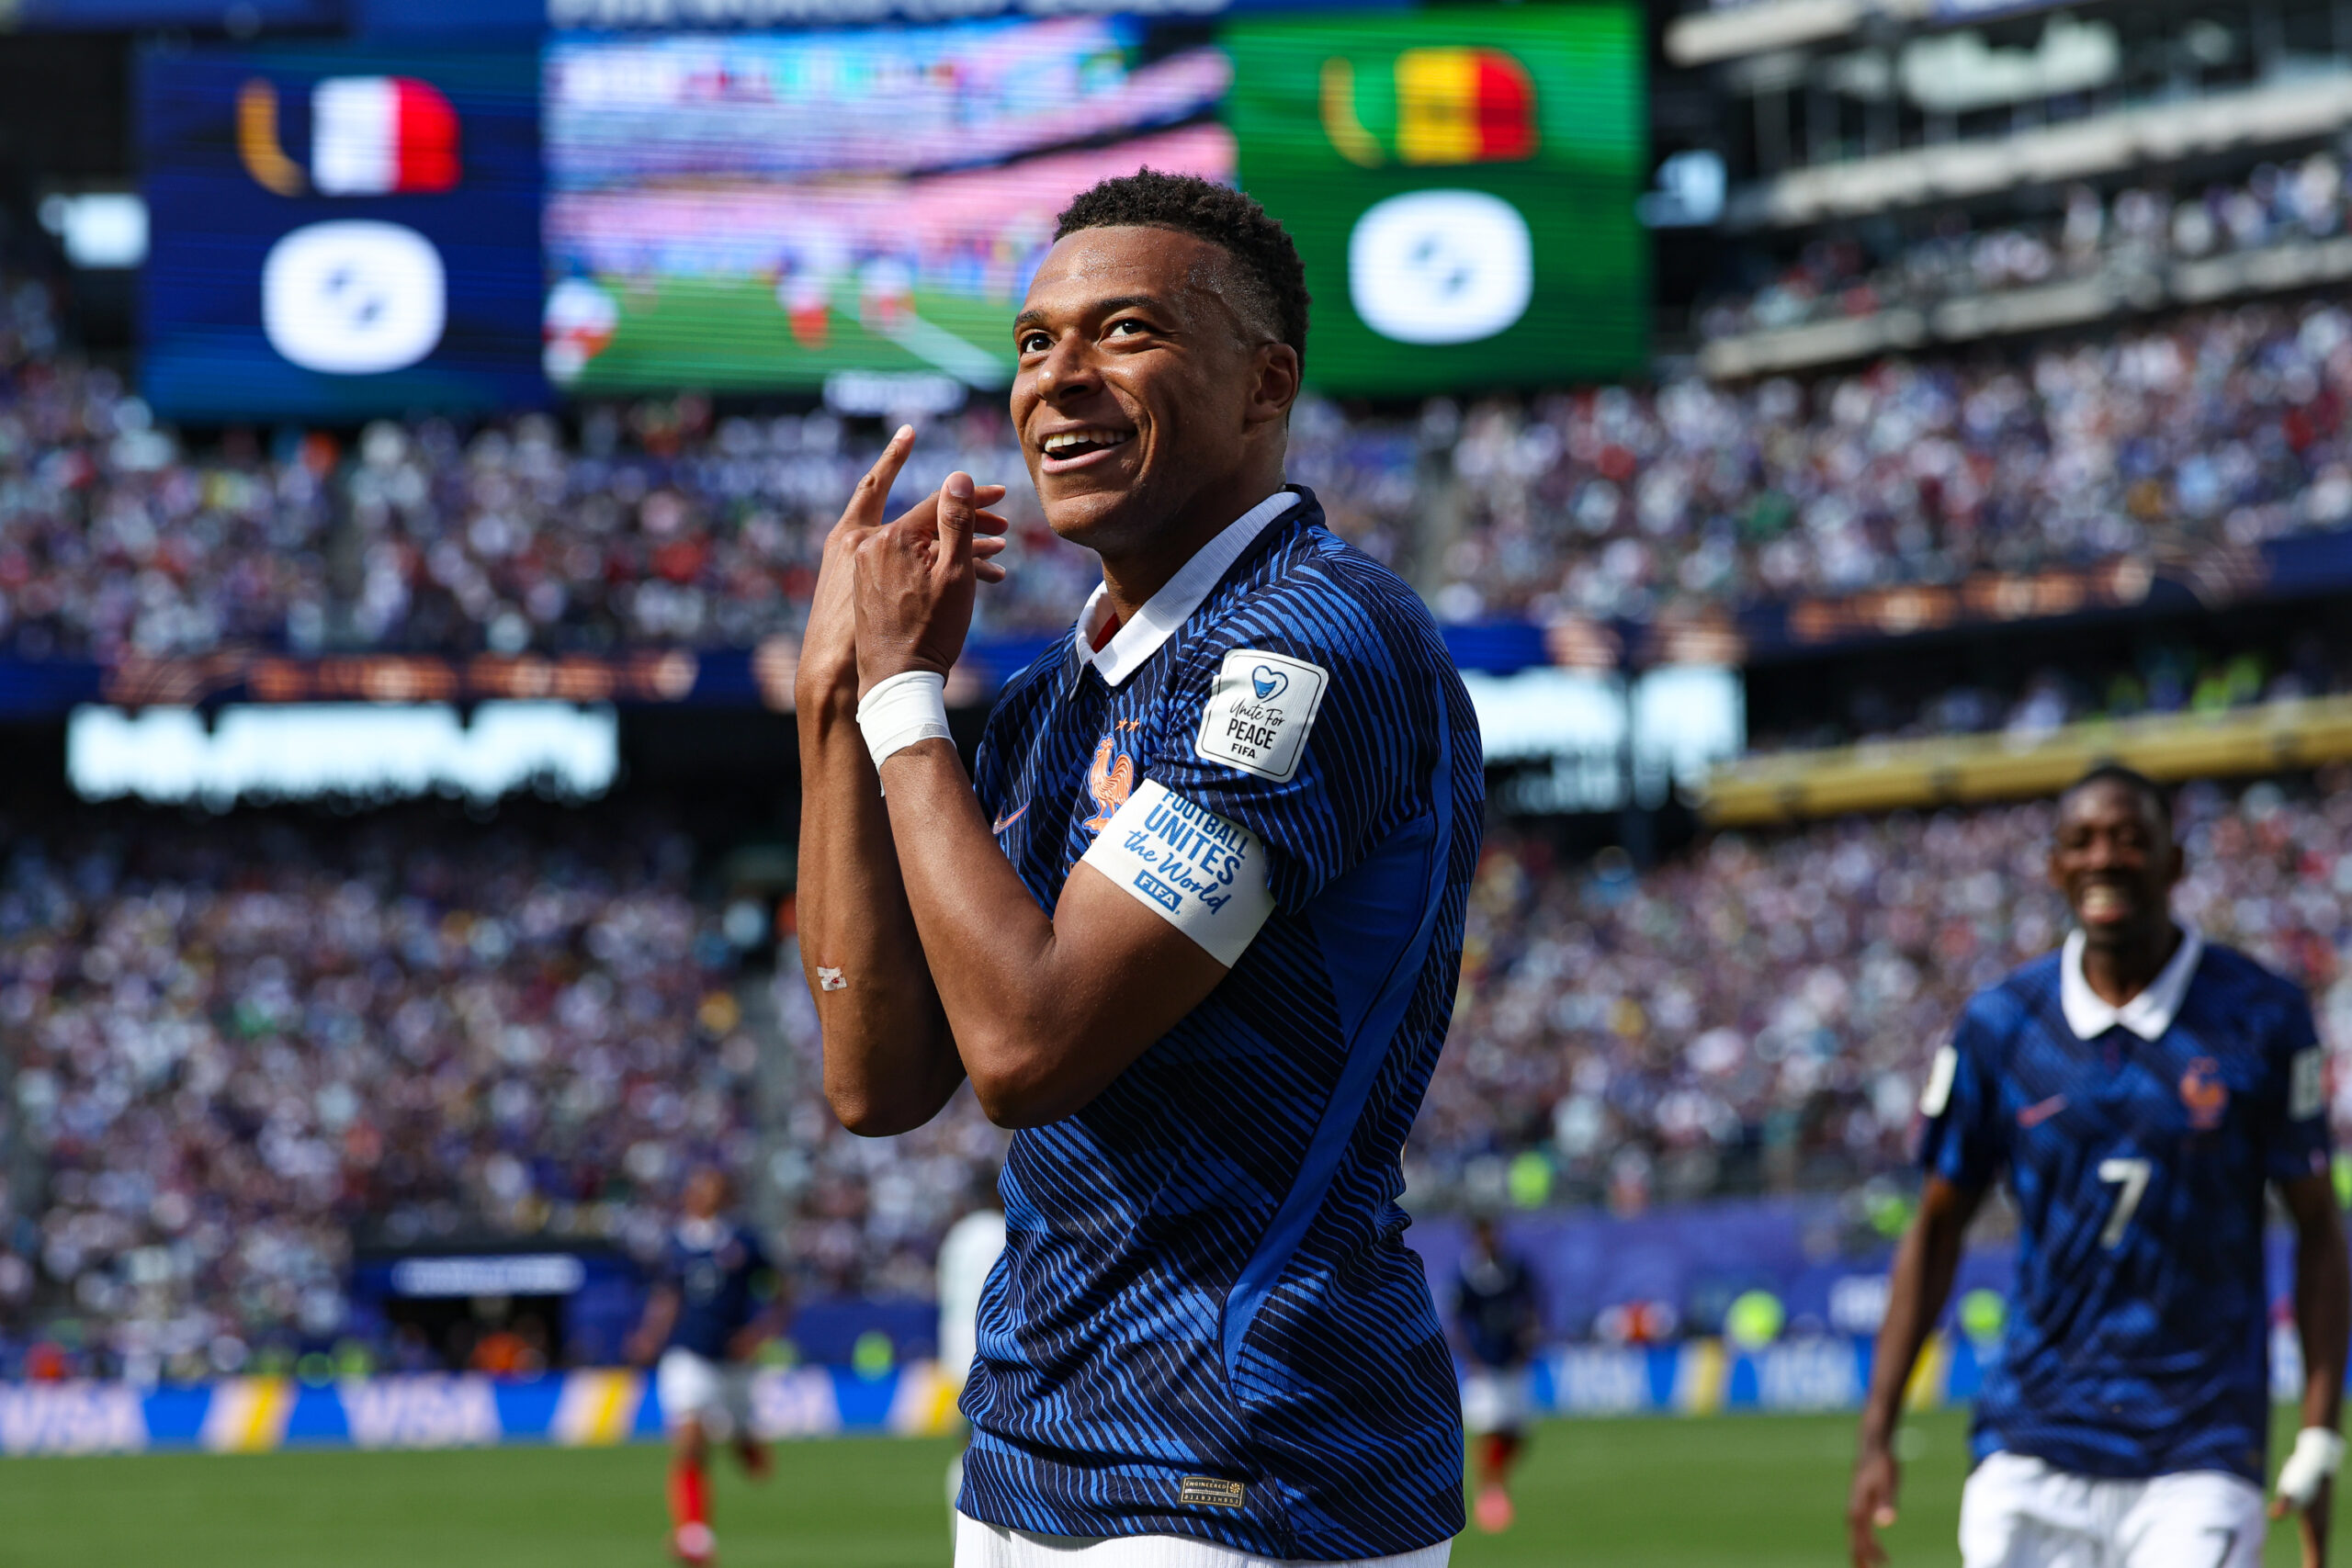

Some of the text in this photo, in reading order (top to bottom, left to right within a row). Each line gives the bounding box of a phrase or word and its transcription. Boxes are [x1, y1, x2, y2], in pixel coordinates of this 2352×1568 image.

[1227, 718, 1277, 750] PEACE
[1229, 698, 1285, 727] Unite For
[1230, 743, 1256, 759] FIFA
[1144, 804, 1240, 886] UNITES
[1161, 790, 1250, 860] FOOTBALL
[1123, 829, 1231, 915] the World
[1137, 874, 1178, 909] FIFA
[2098, 1157, 2152, 1248] 7
